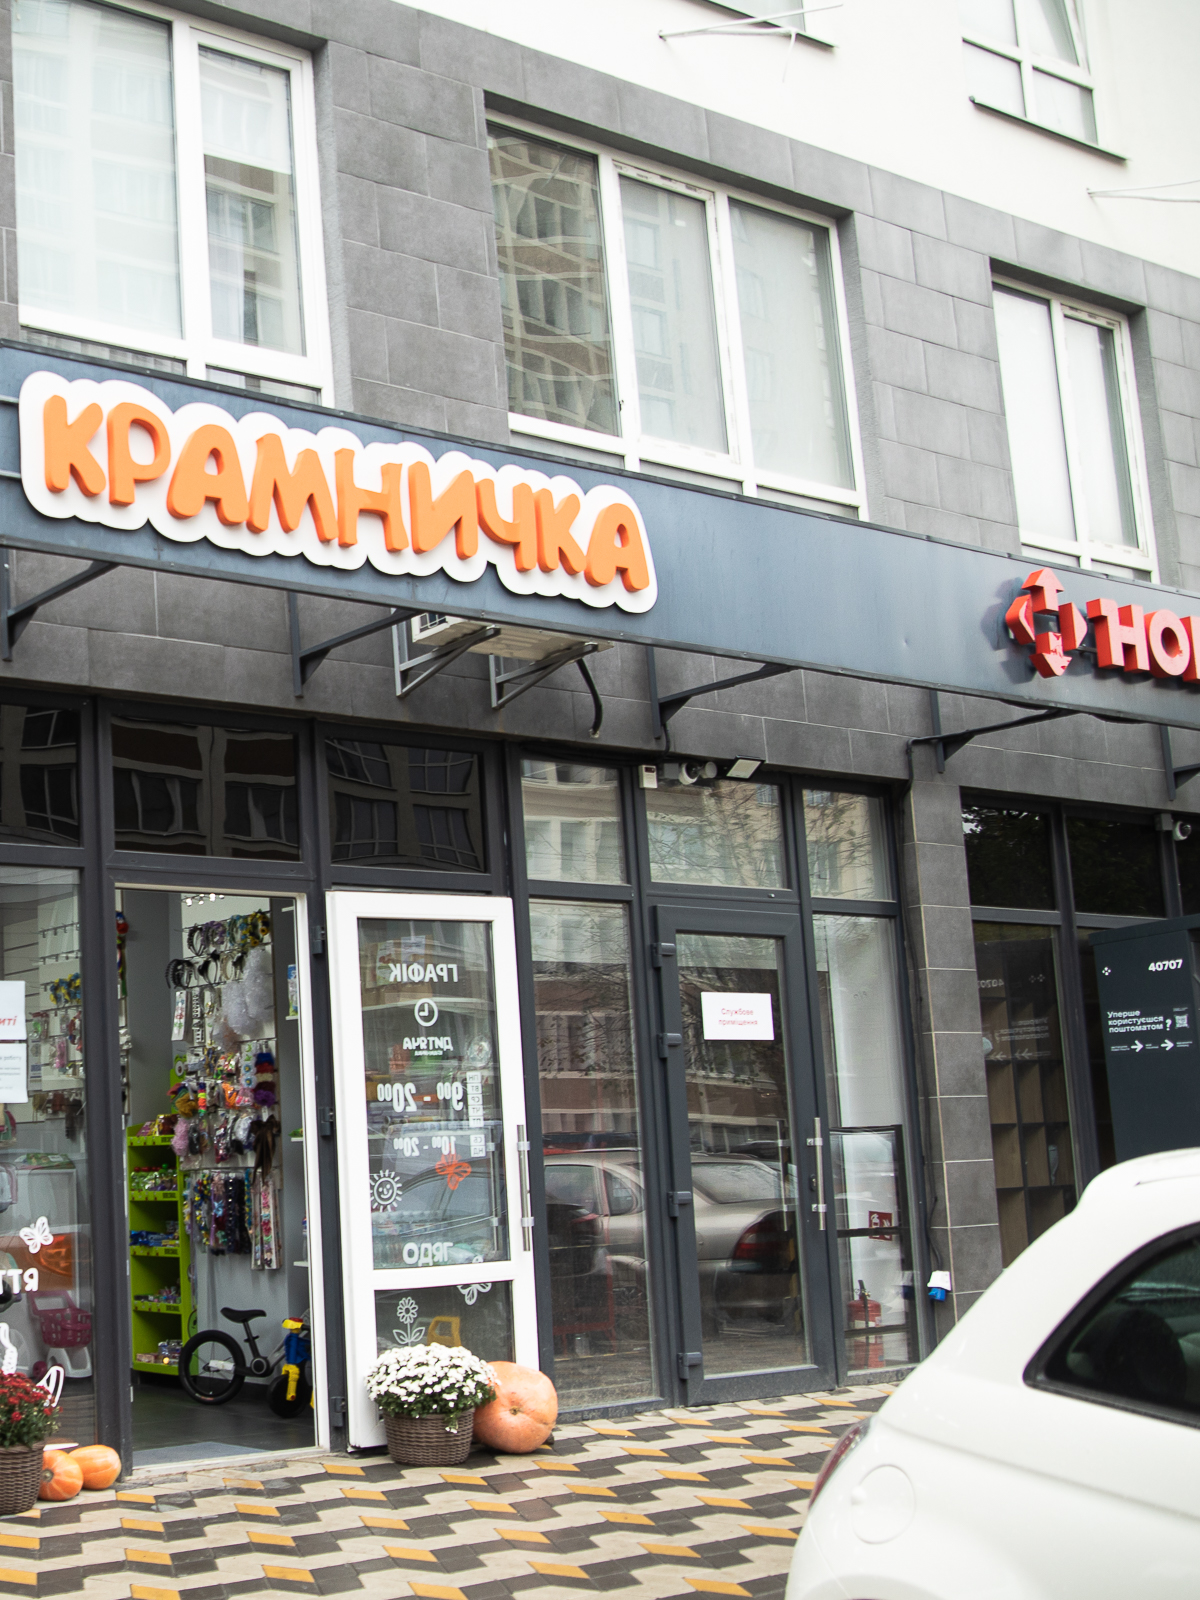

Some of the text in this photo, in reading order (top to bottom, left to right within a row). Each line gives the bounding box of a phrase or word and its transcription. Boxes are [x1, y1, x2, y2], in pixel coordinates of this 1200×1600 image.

[43, 394, 651, 594] КРАМНИЧКА
[1086, 597, 1200, 685] НО
[1147, 959, 1183, 972] 40707
[1106, 1010, 1141, 1019] Уперше
[1107, 1015, 1164, 1026] користуєшся
[1108, 1023, 1164, 1034] поштоматом
[402, 1241, 454, 1267] ОДЯГ
